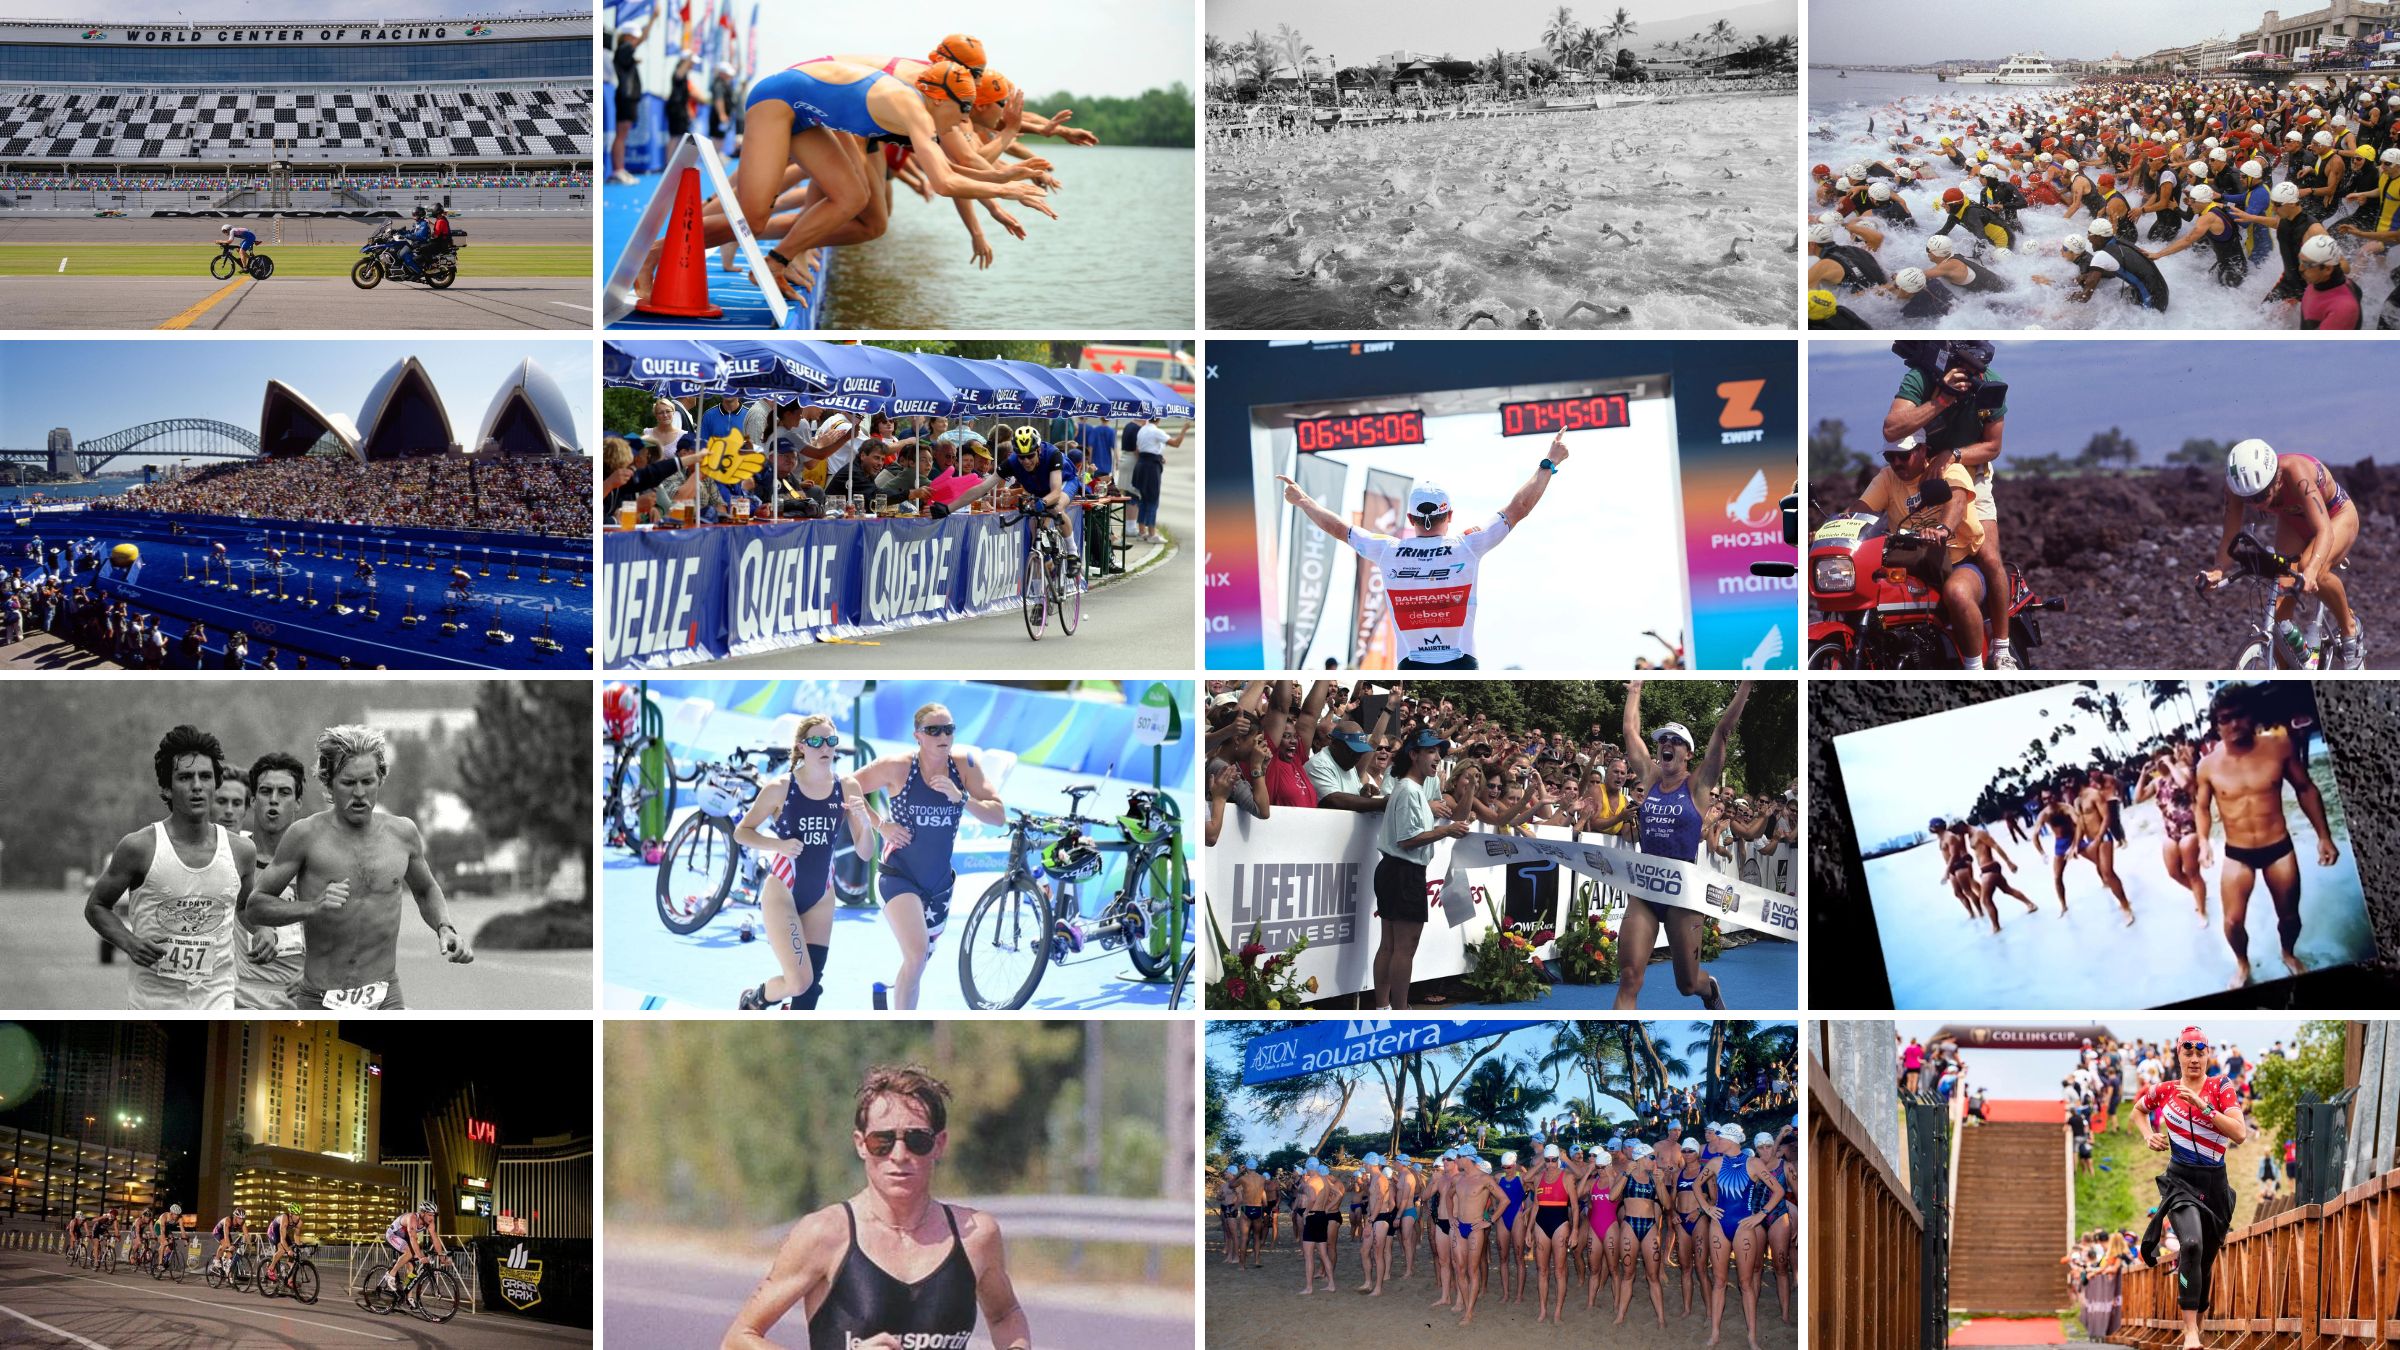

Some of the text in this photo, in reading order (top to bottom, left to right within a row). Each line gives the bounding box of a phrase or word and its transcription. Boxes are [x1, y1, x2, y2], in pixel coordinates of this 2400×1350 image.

[127, 27, 447, 42] WORLD CENTER OF RACING
[150, 210, 405, 218] DAYTONA
[1505, 396, 1627, 435] 07:45:07
[1299, 414, 1419, 451] 06:45:06
[1721, 430, 1764, 444] ZWIFT
[1711, 531, 1783, 549] PHO3NI
[1395, 546, 1453, 557] TRIMTEX
[1395, 594, 1450, 603] BAHRAIN
[1409, 610, 1450, 620] deboer
[1642, 803, 1682, 815] SPEEDO
[798, 817, 837, 831] SEELY
[916, 815, 952, 827] USA
[803, 832, 828, 845] USA
[1634, 863, 1682, 881] NOKIA
[1635, 874, 1682, 896] 5100
[1238, 923, 1350, 949] FTNESS
[169, 946, 206, 970] 457
[1992, 1031, 2048, 1042] COLLINS
[1250, 1039, 1298, 1071] ASTON
[2168, 1099, 2214, 1129] TEAM USA
[469, 1118, 495, 1144] LVH
[502, 1278, 537, 1292] GRAND
[507, 1289, 533, 1301] PRIX
